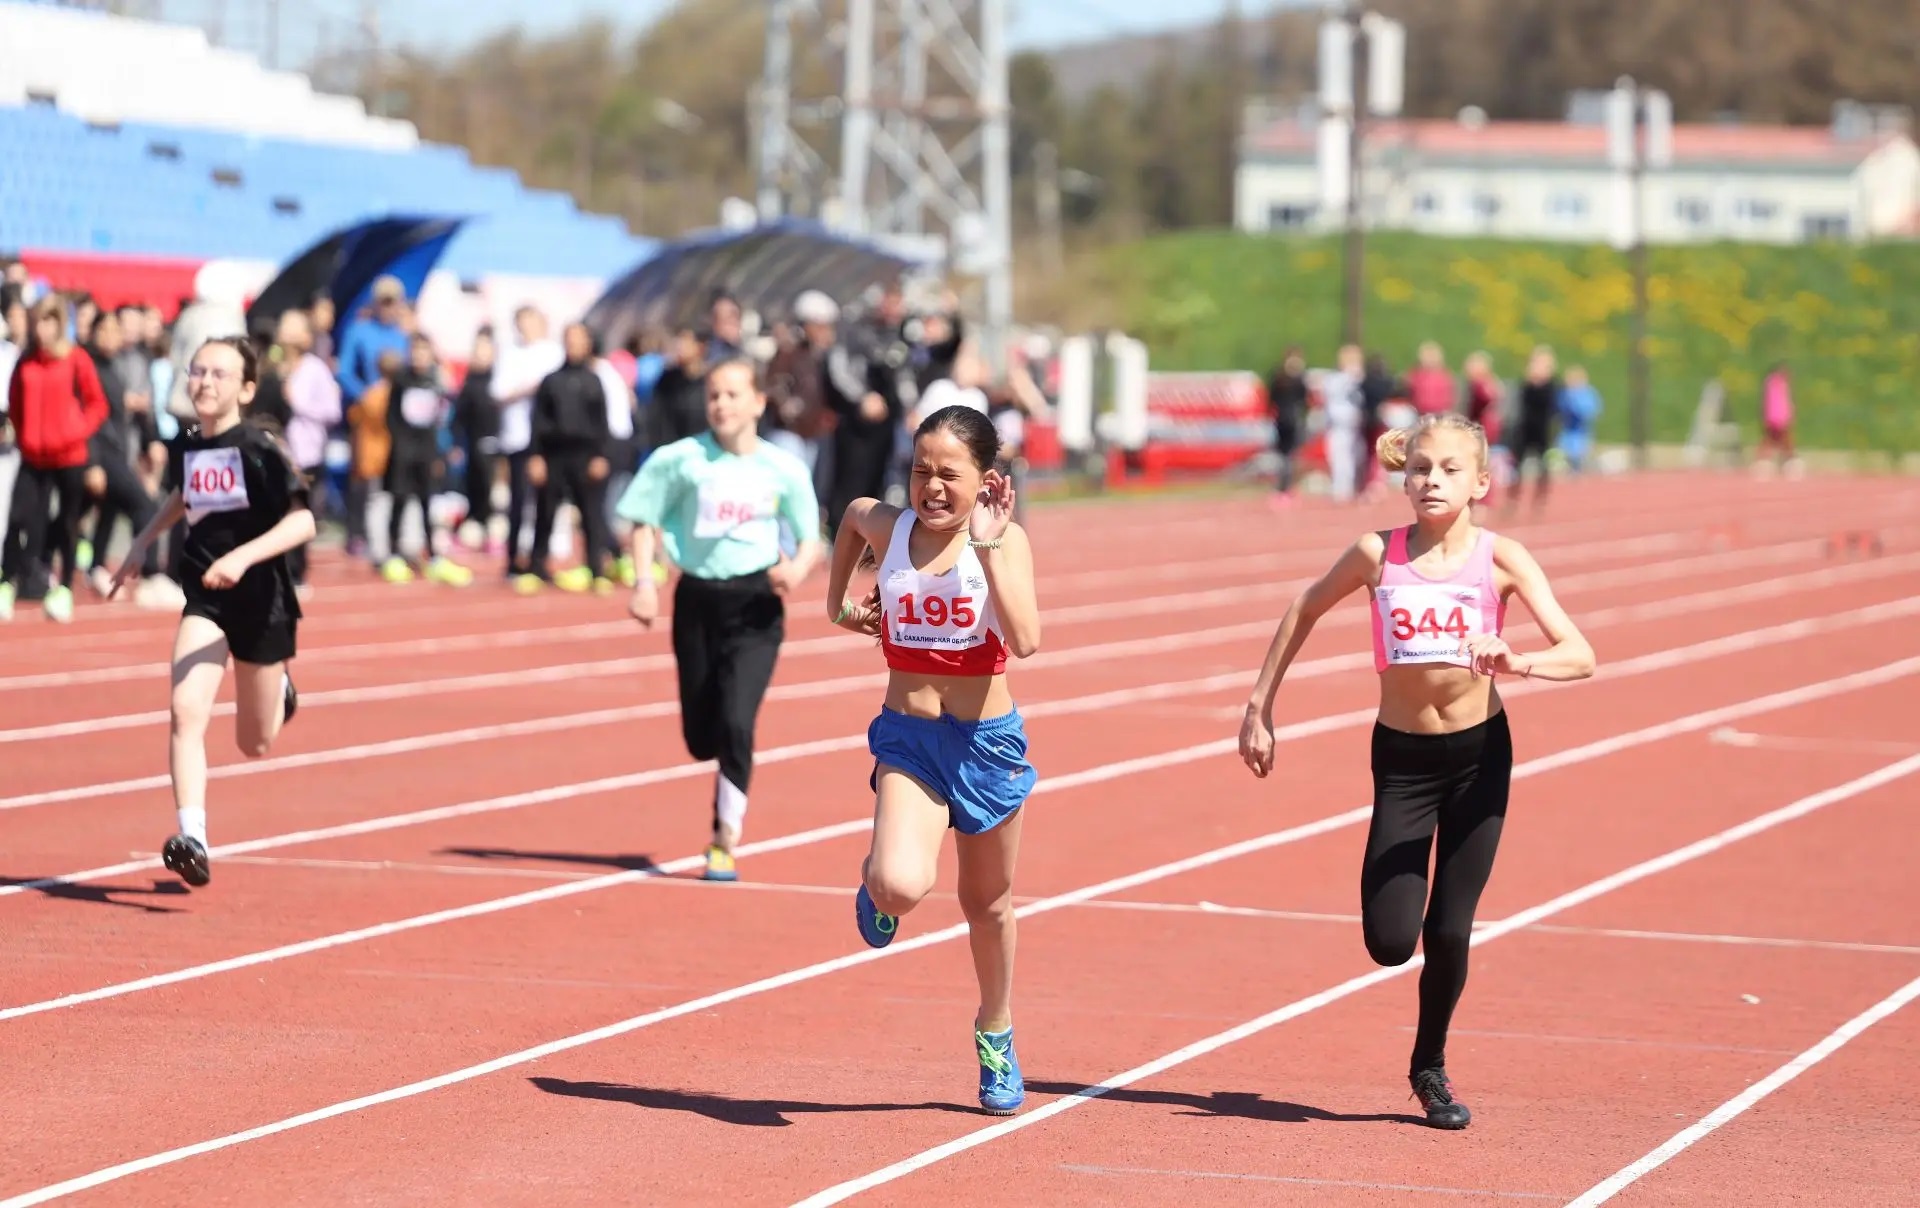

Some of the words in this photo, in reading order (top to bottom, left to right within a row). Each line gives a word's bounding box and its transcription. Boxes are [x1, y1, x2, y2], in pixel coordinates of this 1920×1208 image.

[190, 467, 235, 493] 400
[898, 592, 976, 628] 195
[1391, 606, 1470, 641] 344
[903, 635, 951, 644] САХАЛИНСКАЯ
